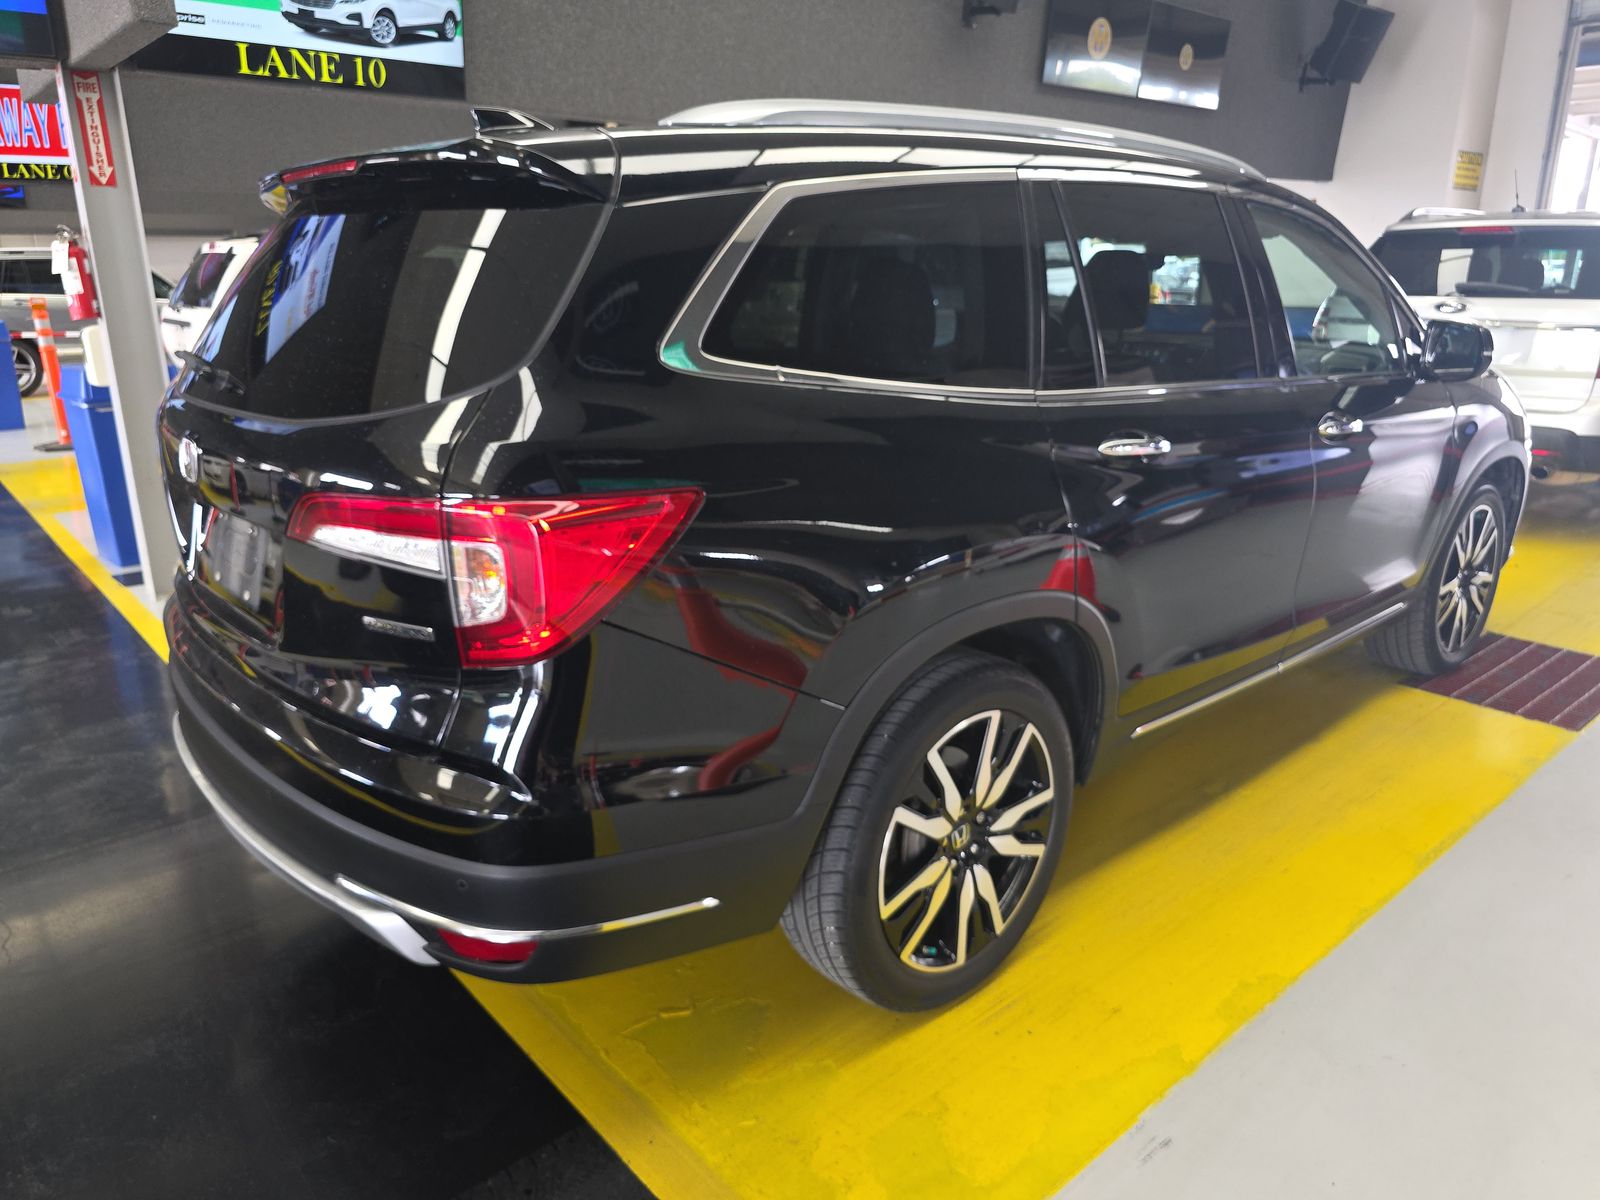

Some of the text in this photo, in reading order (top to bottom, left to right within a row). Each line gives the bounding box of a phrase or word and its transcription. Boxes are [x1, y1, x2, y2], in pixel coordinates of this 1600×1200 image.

[76, 81, 98, 94] FIRE
[235, 42, 387, 88] LANE 10
[0, 97, 50, 148] WAY
[86, 97, 107, 178] EXTINGUISHER
[1, 162, 60, 179] LANE
